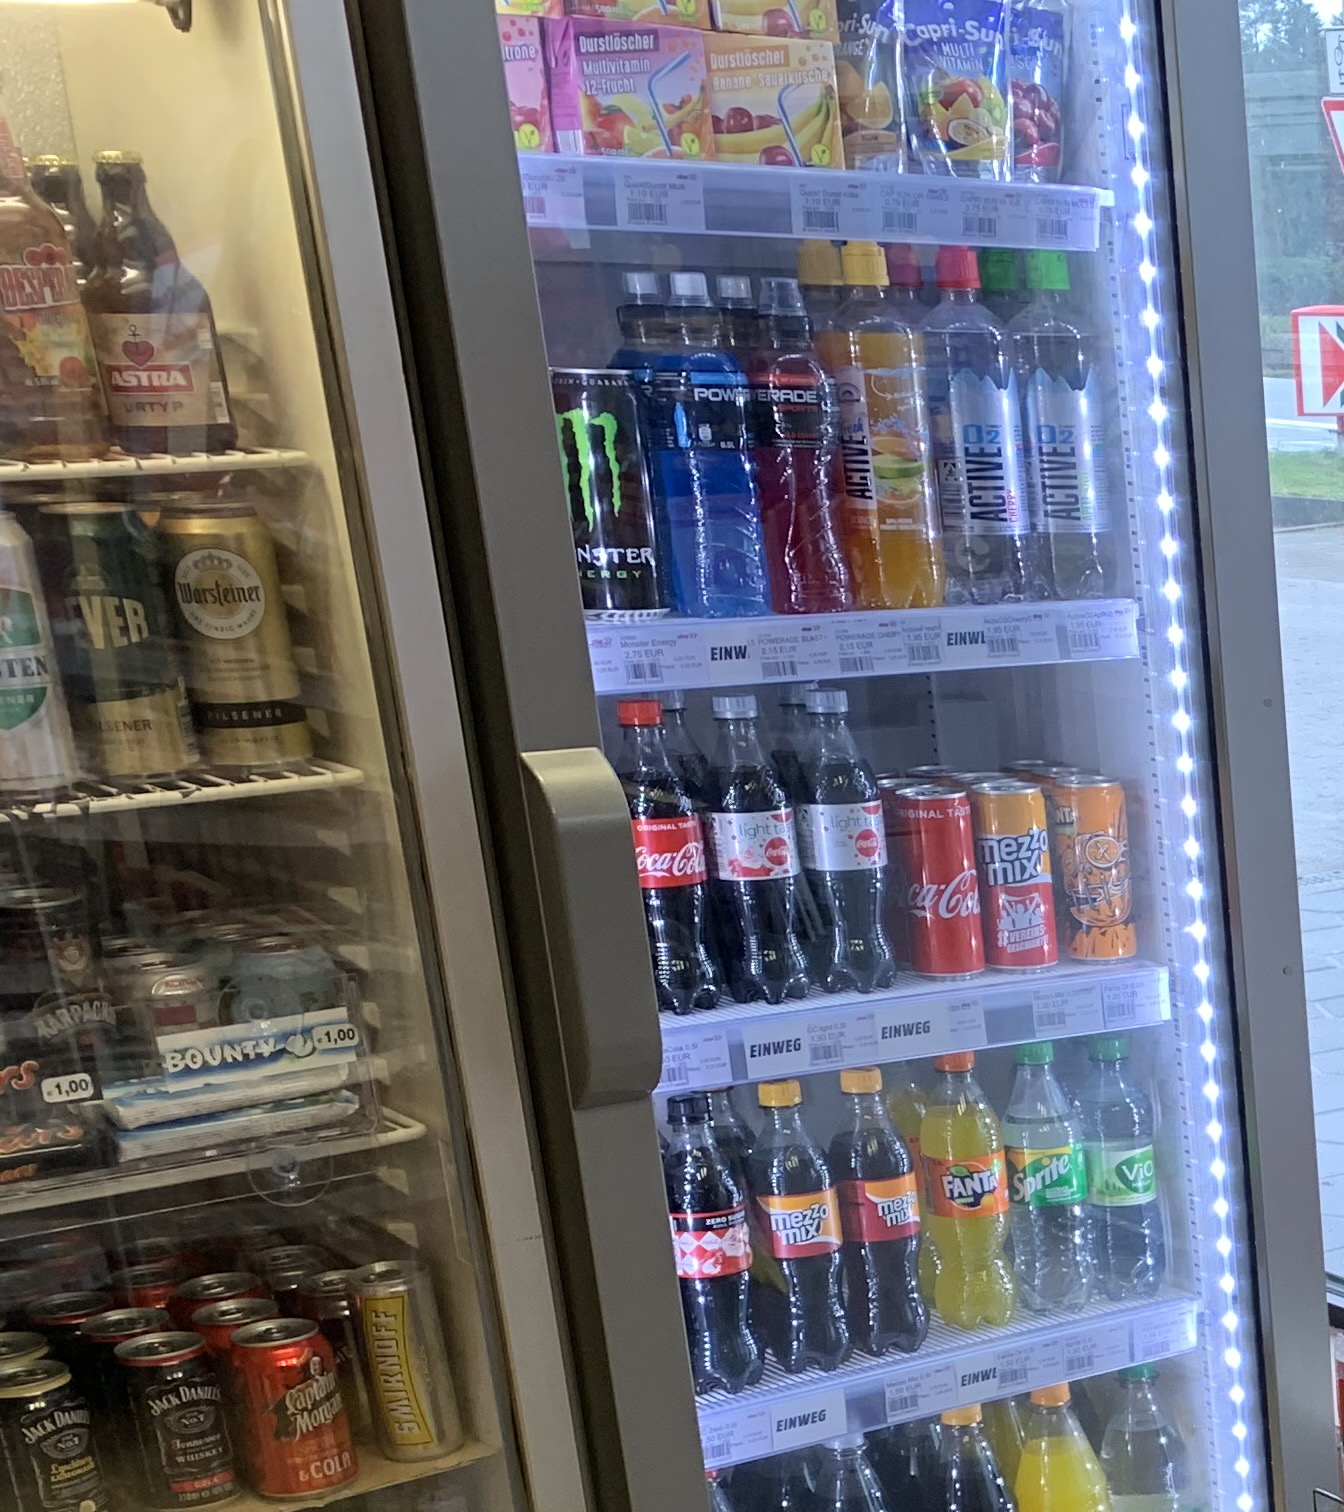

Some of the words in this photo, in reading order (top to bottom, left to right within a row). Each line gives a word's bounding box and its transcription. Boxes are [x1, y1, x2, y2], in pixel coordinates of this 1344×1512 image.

[579, 32, 657, 52] Durstlöscher
[583, 57, 651, 75] Multivitamin
[111, 368, 186, 389] ASTRA
[969, 444, 1004, 523] ACTIVE
[178, 581, 262, 606] Warsteiner
[207, 708, 283, 722] PILSENER
[881, 1021, 930, 1039] EINWEG
[166, 1037, 277, 1073] BOUNTY
[750, 1039, 801, 1059] EINWEG
[770, 1202, 829, 1230] mezzo
[781, 1217, 822, 1245] mix
[372, 1307, 416, 1436] SMIRNOFF
